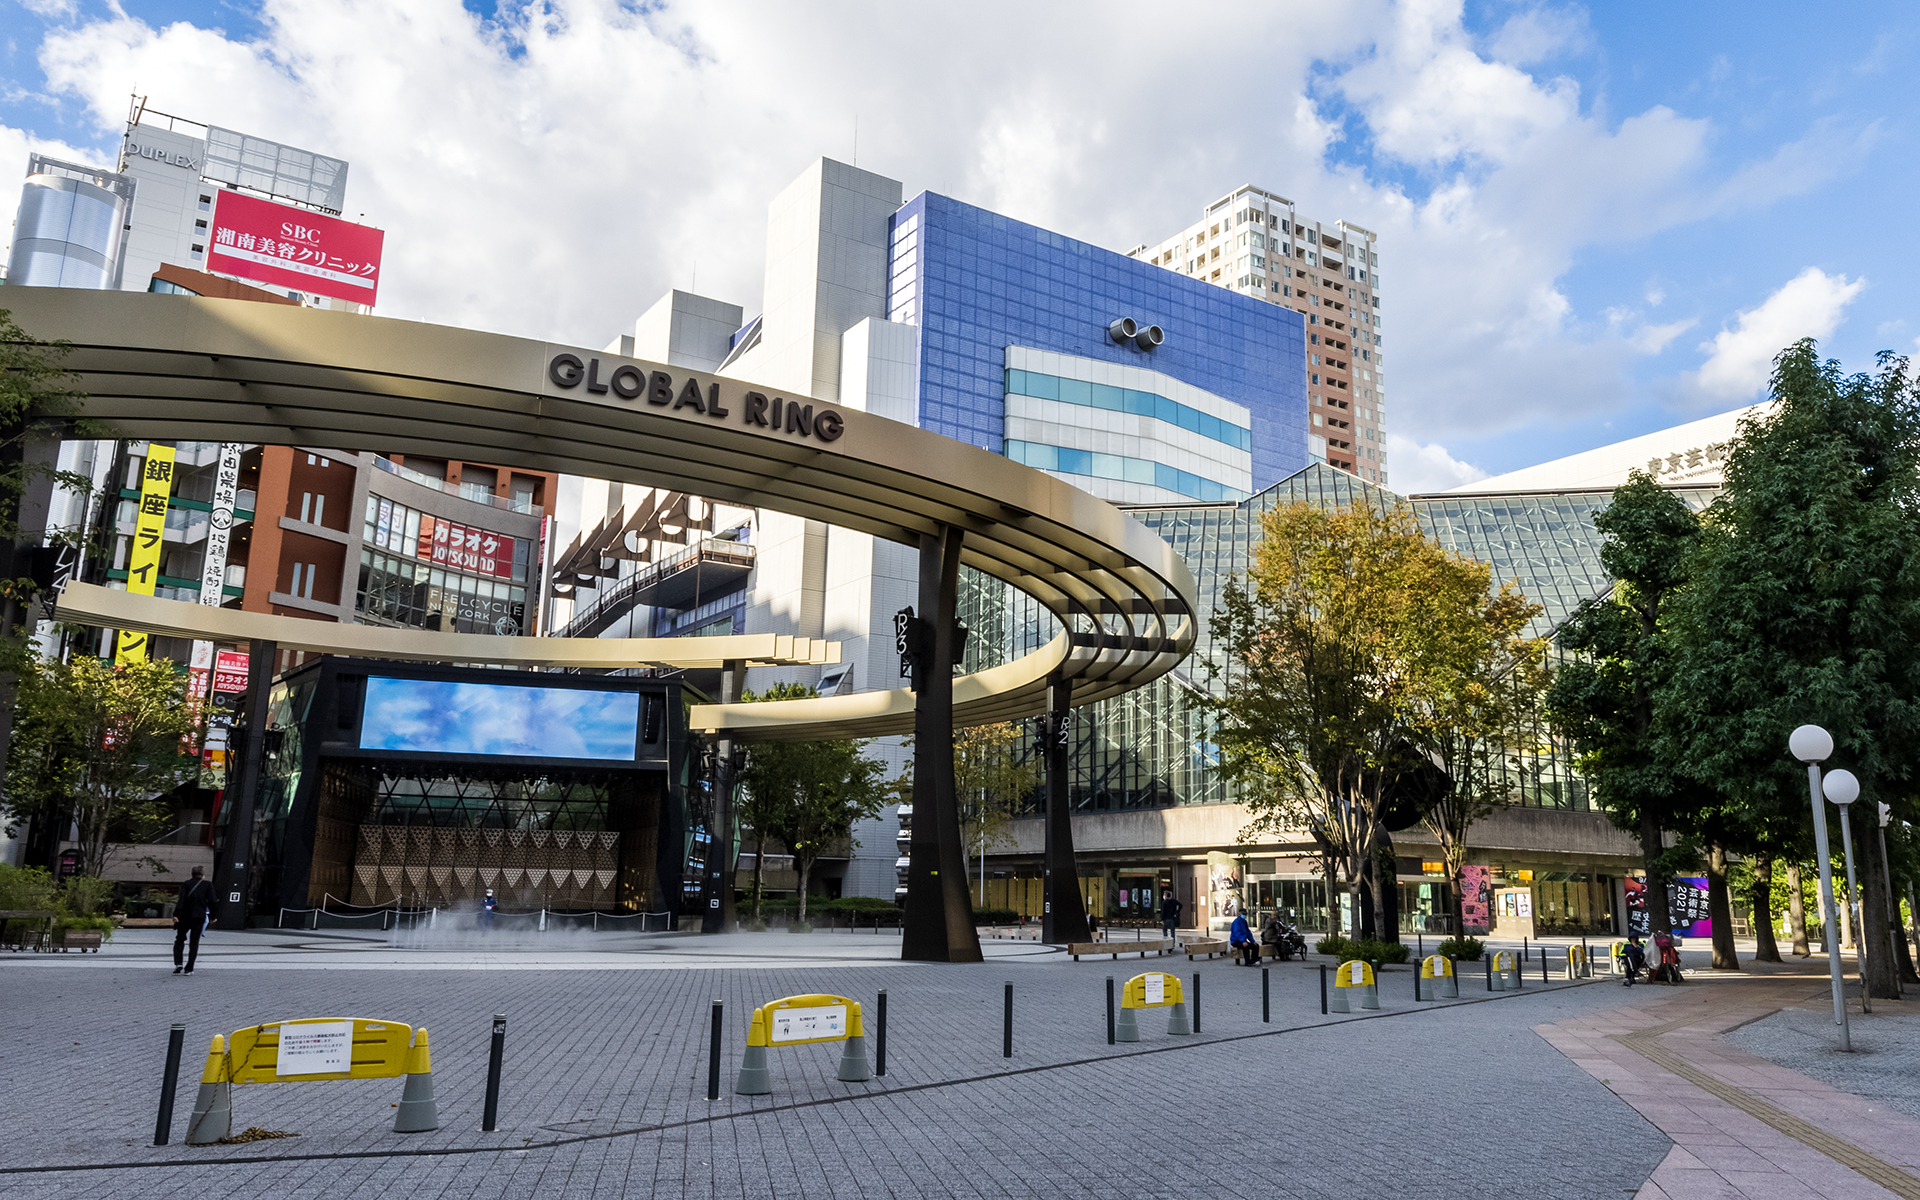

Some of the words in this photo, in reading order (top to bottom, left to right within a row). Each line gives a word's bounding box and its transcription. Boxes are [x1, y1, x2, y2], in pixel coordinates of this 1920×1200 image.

[127, 142, 198, 173] DUPLEX
[280, 222, 321, 244] SBC
[216, 226, 376, 277] 湘南美容クリニック
[549, 353, 729, 417] GLOBAL
[745, 390, 845, 442] RING
[434, 523, 501, 555] カラオケ
[432, 546, 496, 572] JOYSOUND
[429, 602, 457, 613] NEW
[457, 608, 491, 621] YORK
[430, 589, 523, 617] FEELCYCLE
[1676, 885, 1688, 912] 2021
